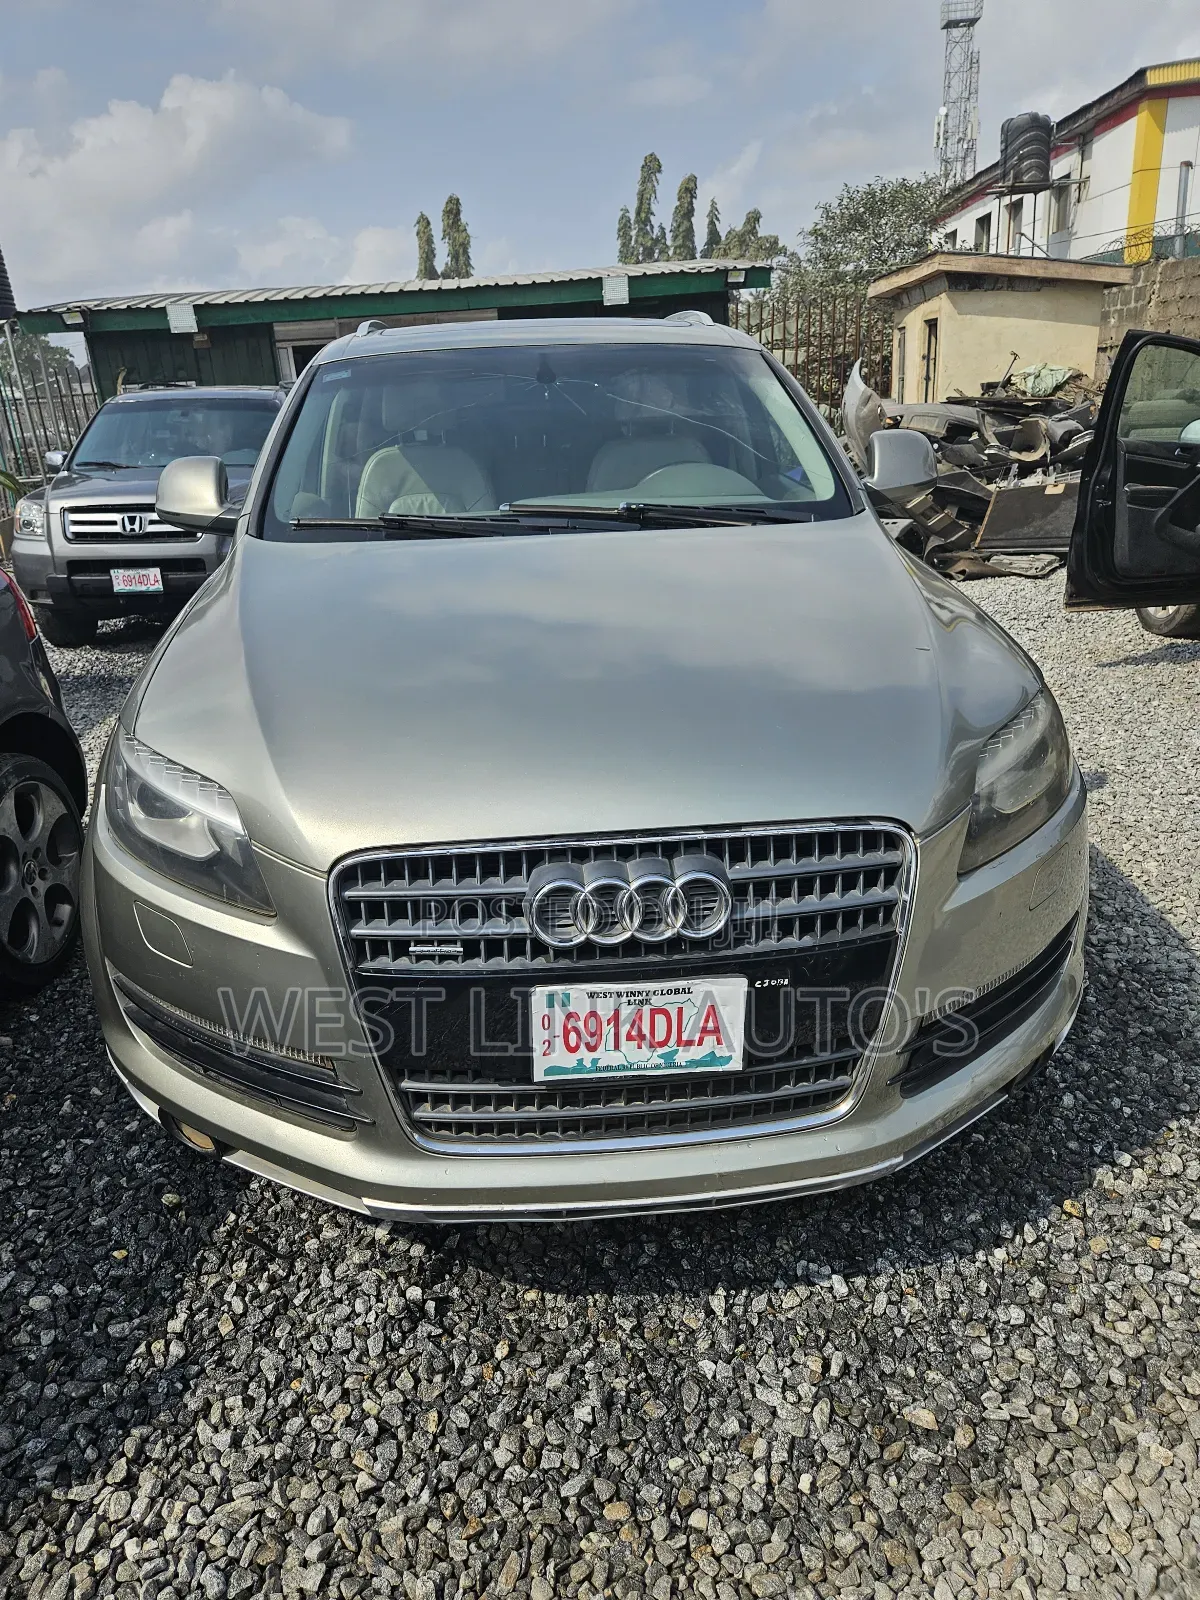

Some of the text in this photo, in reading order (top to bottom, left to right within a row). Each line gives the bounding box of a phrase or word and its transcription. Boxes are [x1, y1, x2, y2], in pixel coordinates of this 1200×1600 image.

[122, 573, 161, 587] 6914DLA
[586, 987, 693, 999] WEST WINNY GLOBAL
[627, 998, 652, 1006] LINK
